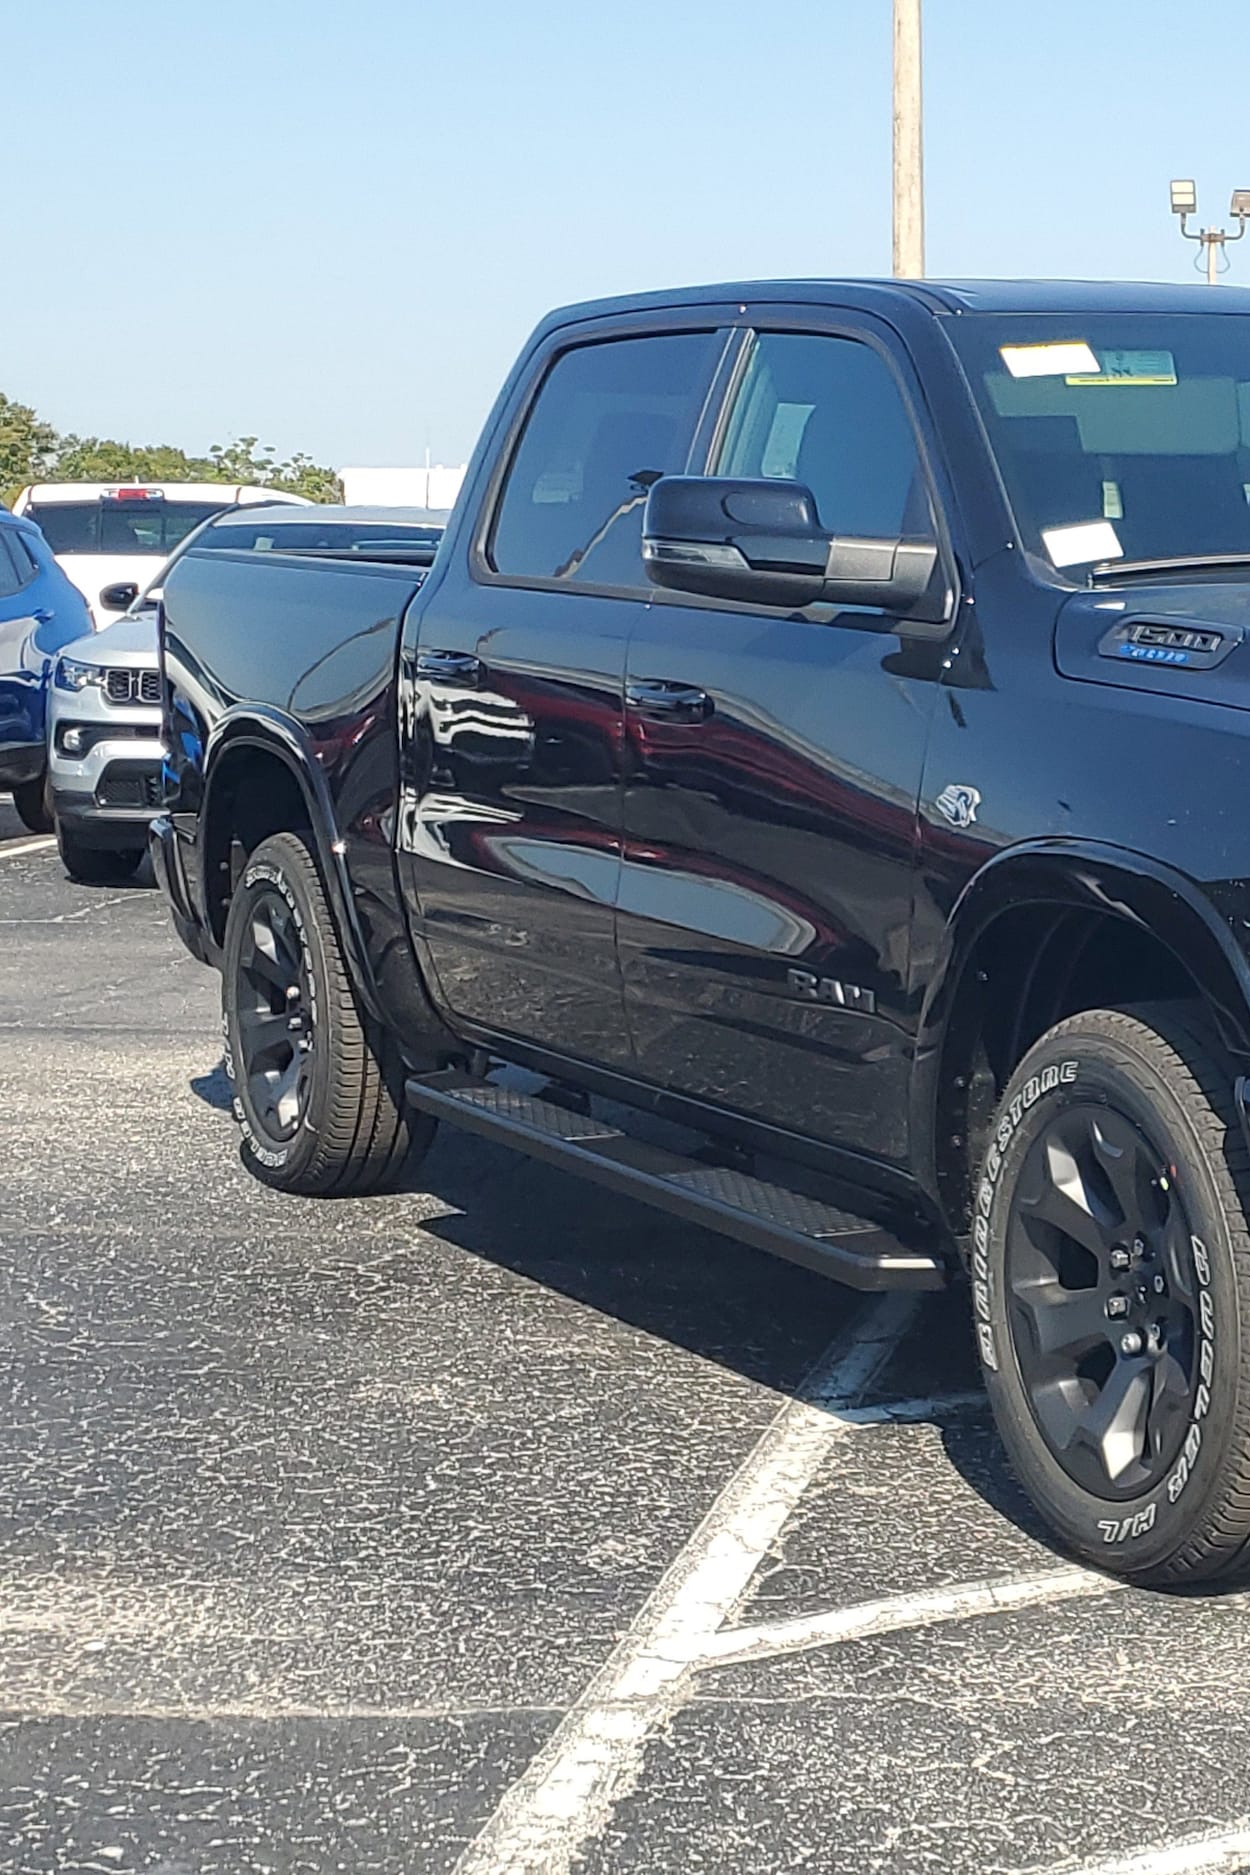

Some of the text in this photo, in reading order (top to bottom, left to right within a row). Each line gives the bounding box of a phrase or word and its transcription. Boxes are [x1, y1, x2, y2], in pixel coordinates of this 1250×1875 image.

[788, 968, 875, 1013] RAM
[971, 1060, 1079, 1372] BRIDGESTONE
[1167, 1234, 1214, 1503] DUELER
